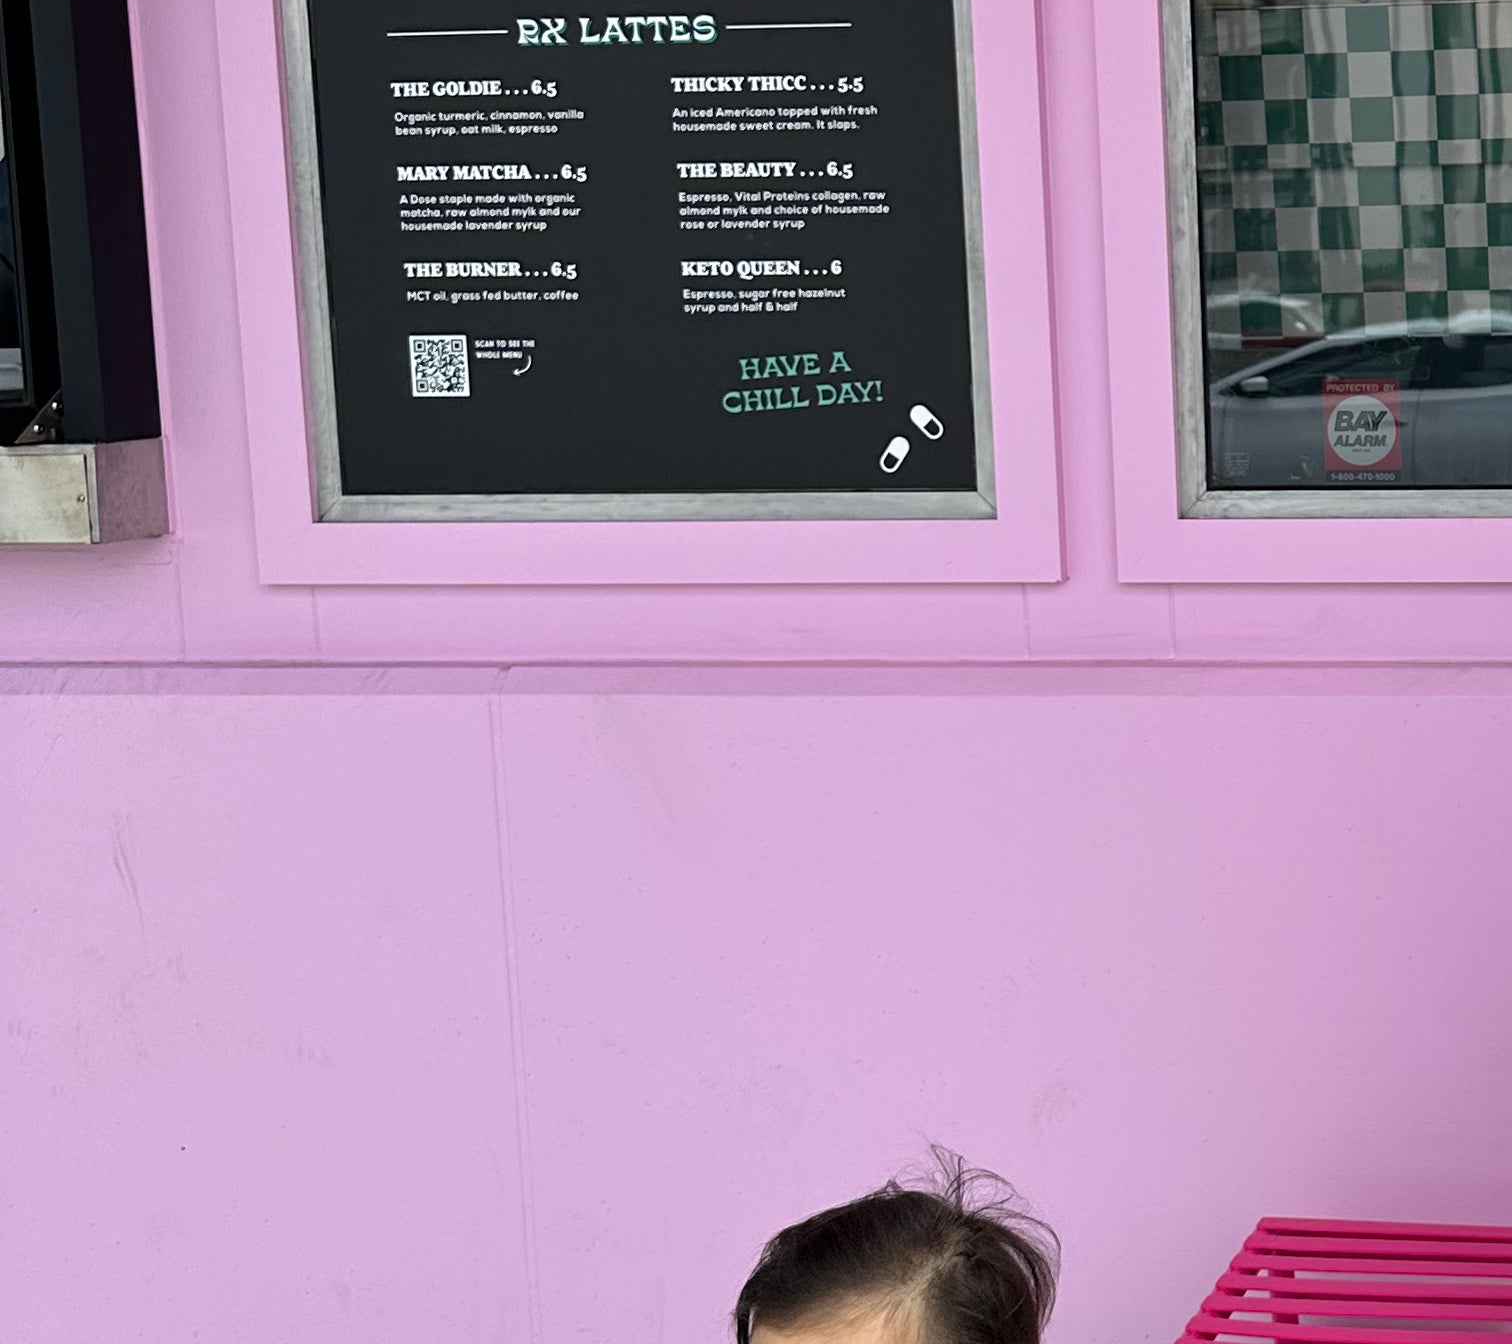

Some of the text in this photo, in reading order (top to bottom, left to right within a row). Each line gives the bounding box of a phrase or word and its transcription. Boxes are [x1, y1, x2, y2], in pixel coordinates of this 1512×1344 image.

[517, 15, 718, 47] RX LATTES
[390, 79, 557, 97] THE GOLDIE 6.5
[670, 76, 864, 94] THICKY THICC 5.5
[394, 112, 437, 125] Organic
[547, 109, 584, 119] vanilla
[672, 105, 878, 118] An iced Americano topped with fresh
[395, 126, 423, 135] bean
[461, 125, 479, 134] oat
[508, 125, 558, 135] espresso
[672, 121, 737, 132] housemade
[739, 121, 774, 131] sweet
[816, 120, 825, 129] It
[397, 164, 587, 182] MARY MATCHA 6.5
[676, 161, 853, 179] THE BEAUTY 6.5
[403, 262, 577, 280] THE BURNER 6.5
[681, 260, 842, 280] KETO QUEEN 6
[407, 290, 431, 301] MCT
[451, 292, 481, 304] grass
[482, 290, 501, 301] fed
[543, 290, 579, 300] coffee
[738, 290, 770, 302] sugar
[772, 288, 796, 298] free
[798, 288, 846, 298] hazelnut
[684, 301, 798, 314] syrup and half & half
[738, 351, 852, 380] HAVE A
[1326, 383, 1396, 393] PROTECTED BY
[722, 380, 884, 414] CHILL DAY!
[1334, 410, 1388, 432] BAY
[1333, 435, 1387, 447] ALARM
[1331, 472, 1395, 481] 1-800-470-1000
